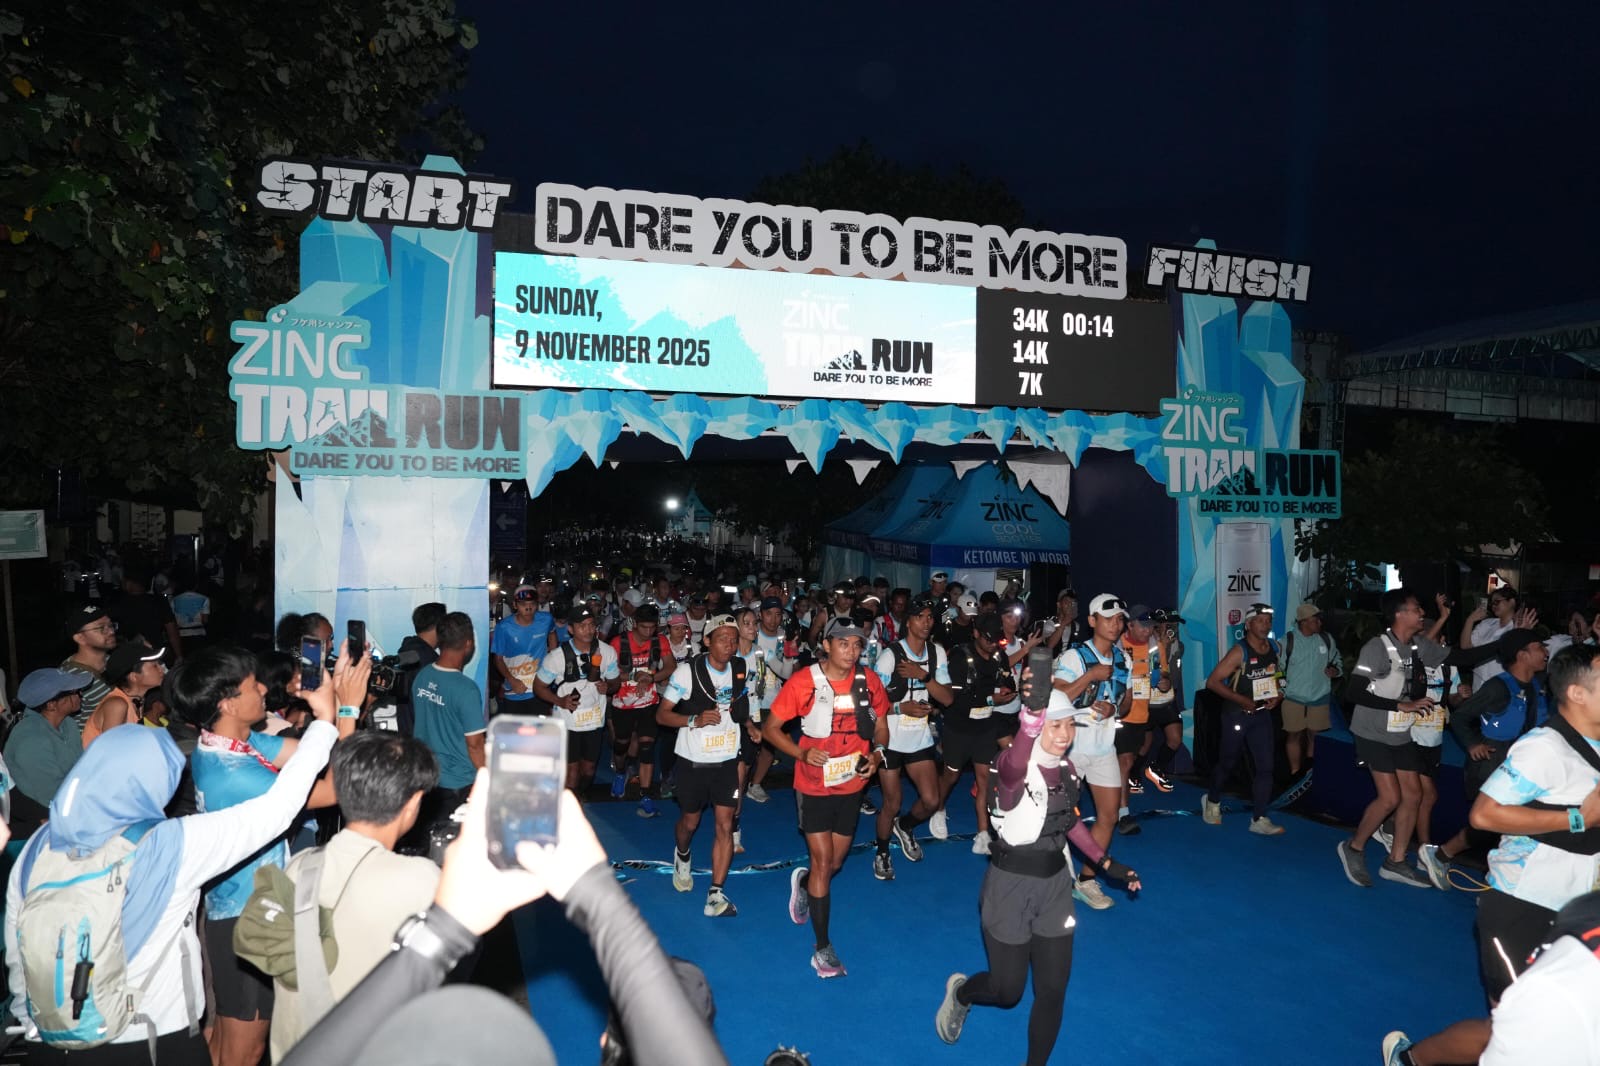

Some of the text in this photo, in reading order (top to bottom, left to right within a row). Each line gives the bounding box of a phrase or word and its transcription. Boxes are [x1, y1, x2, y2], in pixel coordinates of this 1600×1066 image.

[257, 160, 511, 229] START
[547, 196, 1119, 289] DARE YOU TO BE MORE
[1147, 247, 1311, 301] FINISH
[515, 284, 602, 322] SUNDAY,
[782, 299, 851, 330] ZINC
[1013, 307, 1114, 338] 34K 00:14
[232, 327, 363, 380] ZINC
[515, 330, 710, 367] 9 NOVEMBER 2025
[872, 338, 933, 374] RUN
[1013, 339, 1049, 365] 14K
[813, 371, 933, 387] DARE YOU TO BE MORE
[1018, 371, 1043, 396] 7K
[235, 383, 520, 452] TRAIL RUN
[1162, 403, 1240, 443] ZINC
[294, 451, 520, 473] DARE YOU TO BE MORE
[1164, 447, 1337, 498] TRAIL RUN
[980, 502, 1039, 523] ZINC
[1200, 500, 1337, 514] DARE YOU TO BE MORE
[991, 523, 1041, 536] COOL
[963, 550, 1072, 566] KETOMBE NO WORR
[1227, 574, 1262, 592] ZINC
[827, 759, 853, 776] 1259
